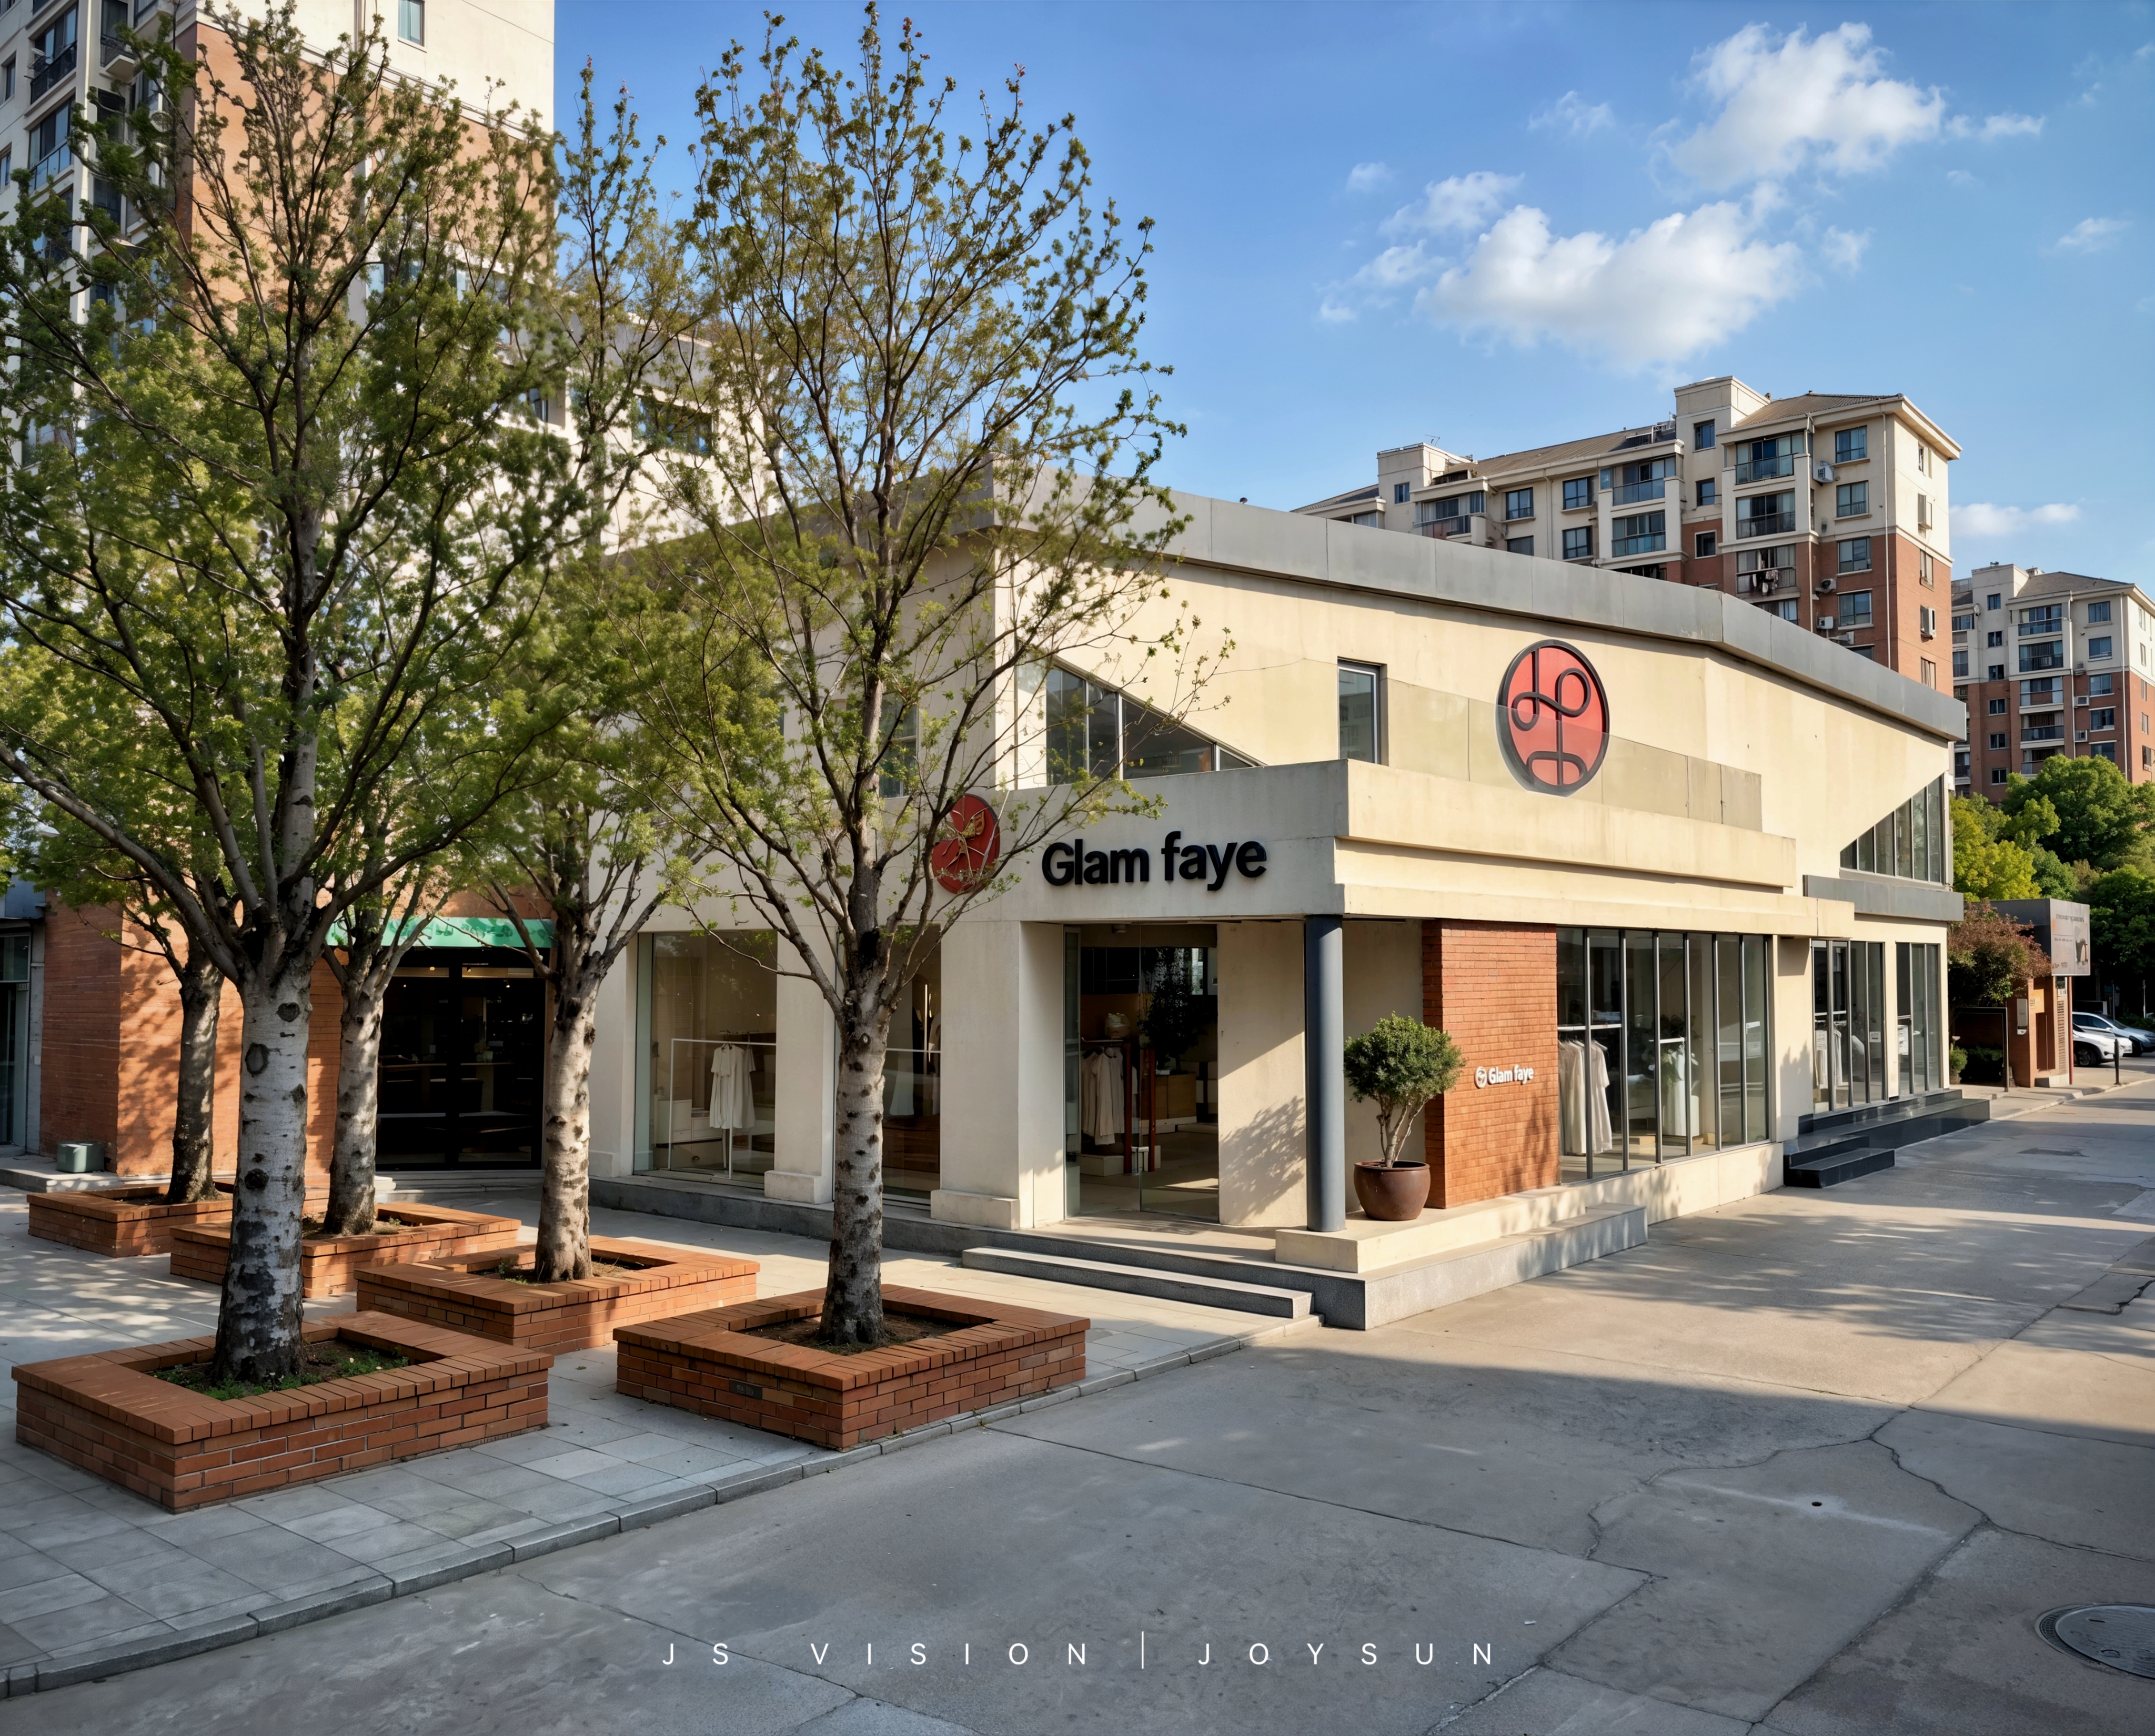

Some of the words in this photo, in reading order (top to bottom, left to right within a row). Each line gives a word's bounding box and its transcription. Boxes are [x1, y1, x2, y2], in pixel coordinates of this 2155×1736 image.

[1042, 839, 1150, 886] Glam
[1161, 831, 1267, 891] faye
[1488, 1066, 1513, 1084] Glam
[1514, 1064, 1534, 1084] faye
